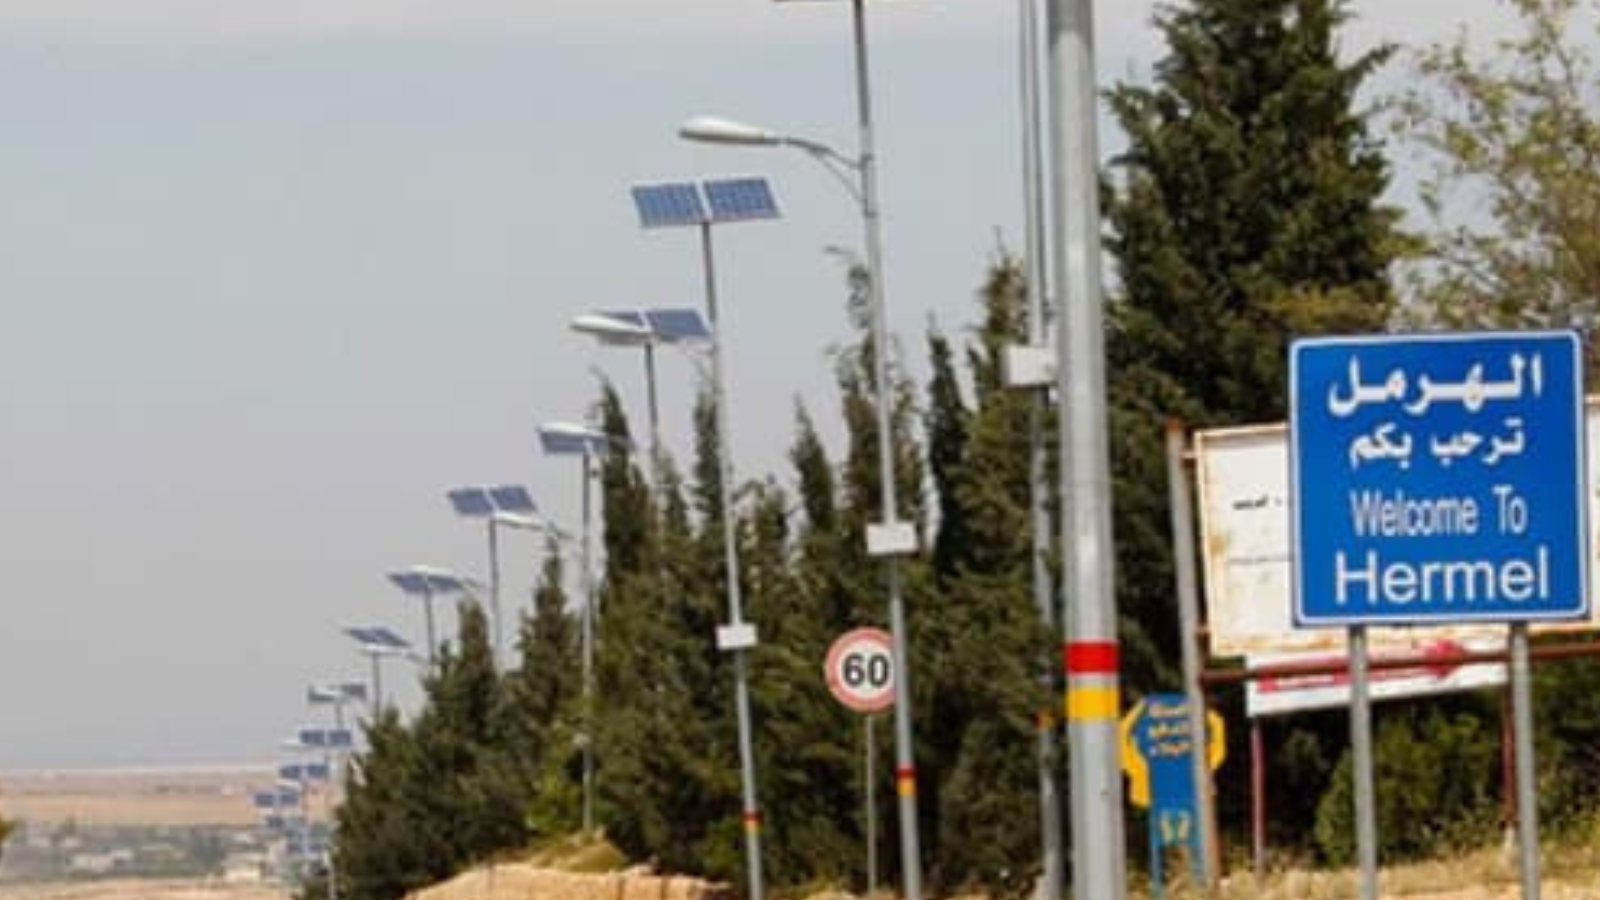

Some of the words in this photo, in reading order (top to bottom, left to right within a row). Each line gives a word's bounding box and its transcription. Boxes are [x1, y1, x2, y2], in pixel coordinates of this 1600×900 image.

[1328, 353, 1542, 415] الهرمل
[1350, 422, 1412, 469] بكم
[1430, 418, 1525, 466] ترحب
[1350, 489, 1478, 536] Welcome
[1492, 485, 1527, 535] To
[1335, 545, 1548, 604] Hermel
[843, 653, 888, 687] 60
